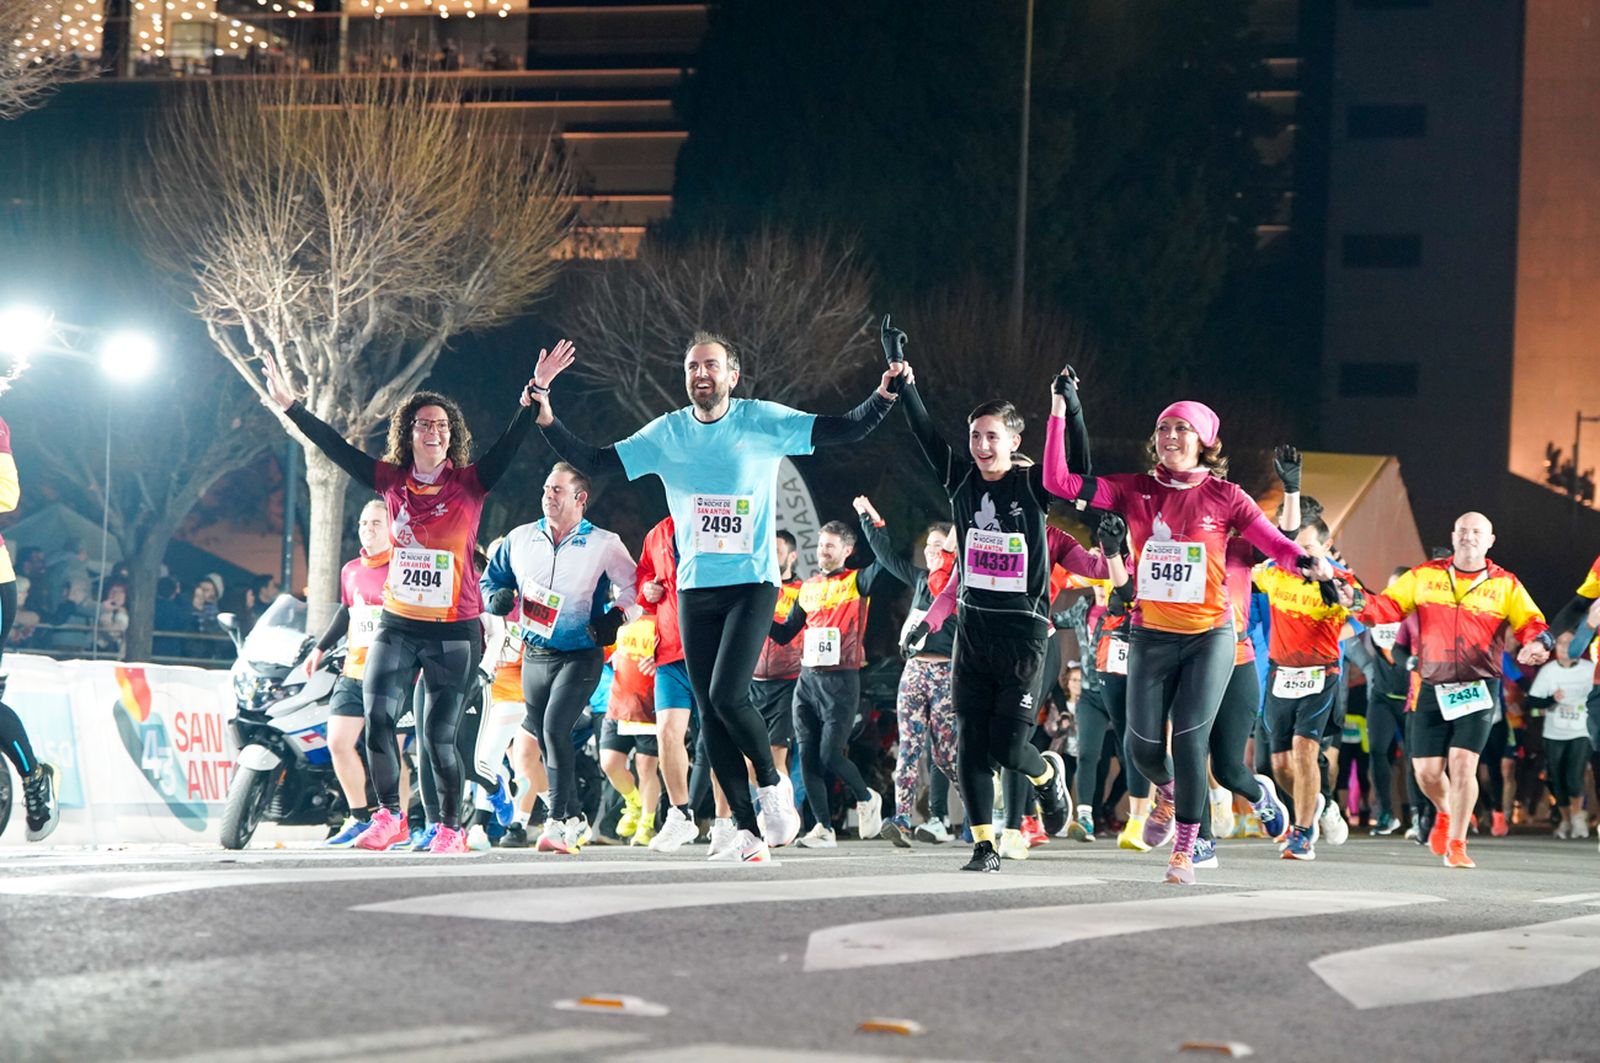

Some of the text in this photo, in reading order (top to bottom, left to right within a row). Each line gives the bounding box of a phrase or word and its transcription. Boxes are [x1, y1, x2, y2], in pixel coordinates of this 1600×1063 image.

[701, 515, 742, 534] 2493
[397, 529, 412, 546] 43
[974, 550, 1019, 572] 14337
[402, 569, 442, 588] 2494
[1151, 562, 1192, 582] 5487
[1448, 687, 1480, 705] 2434
[174, 711, 223, 754] SAN
[141, 730, 177, 797] 43
[187, 760, 239, 800] ANT
